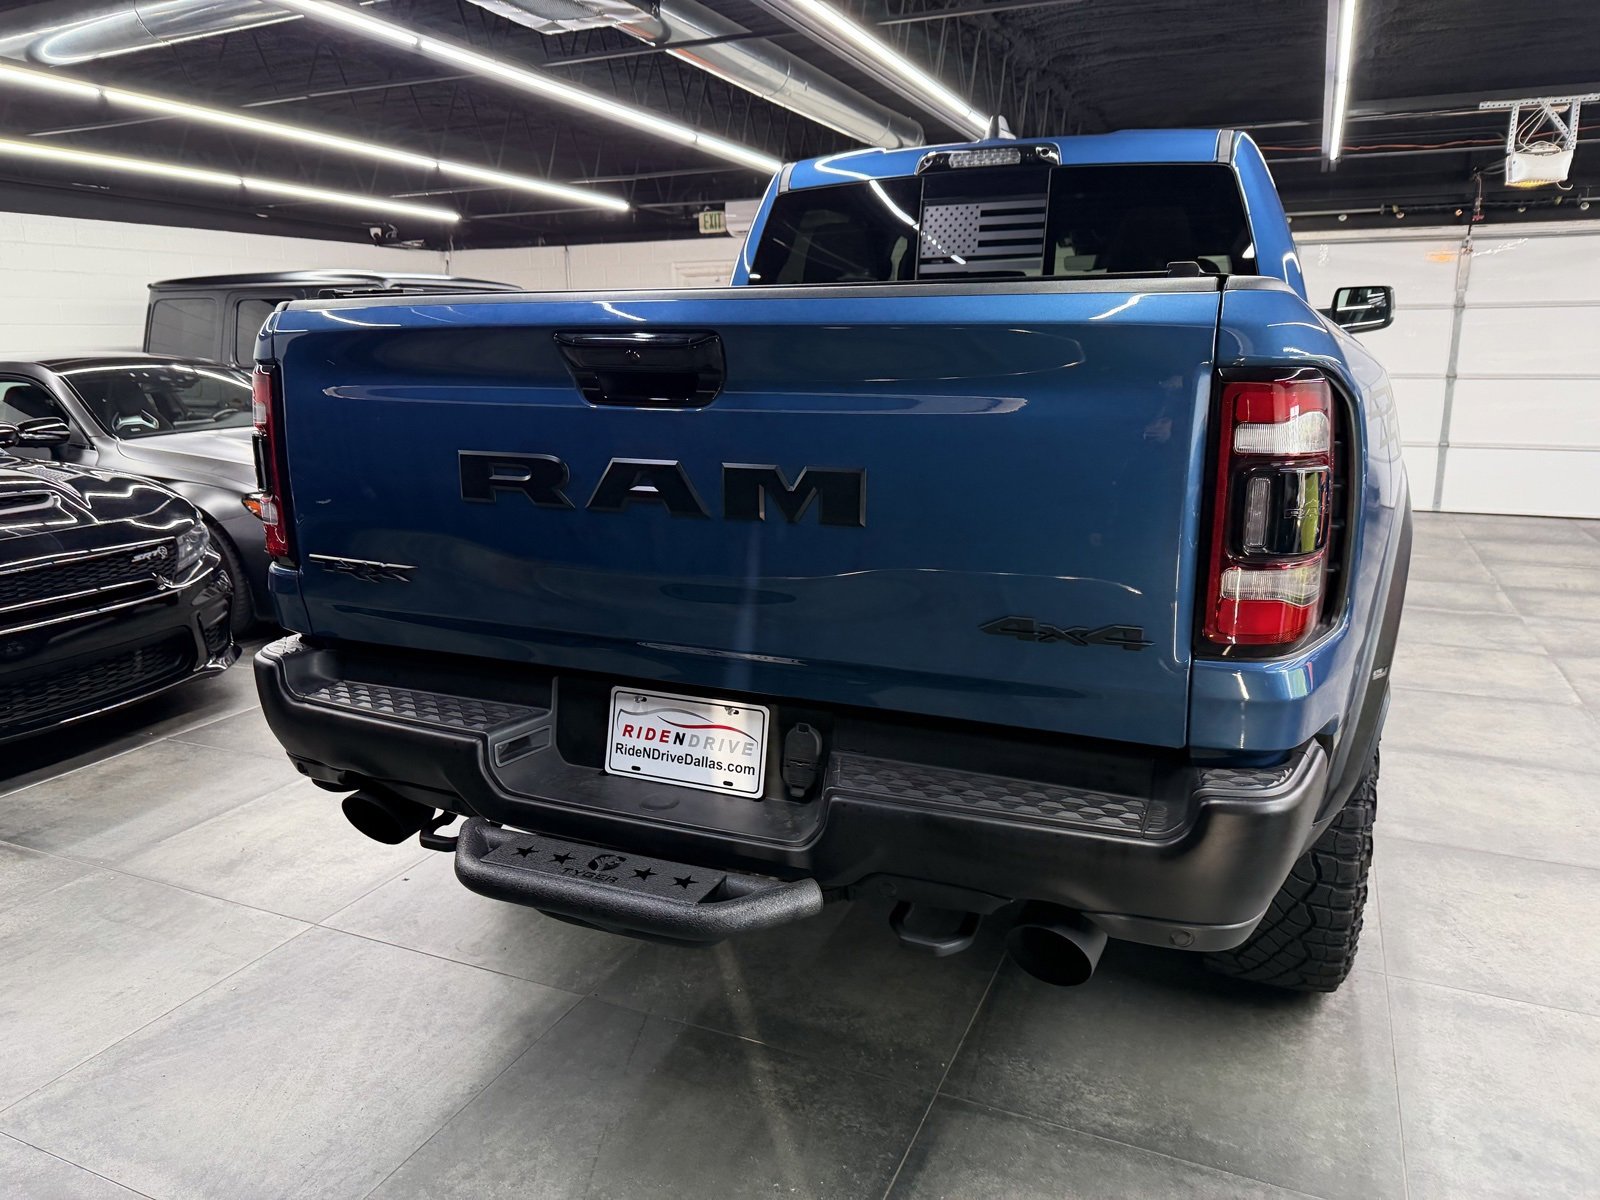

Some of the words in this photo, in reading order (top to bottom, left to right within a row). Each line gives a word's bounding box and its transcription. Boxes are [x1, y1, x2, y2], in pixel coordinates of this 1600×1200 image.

[703, 213, 721, 230] EXIT
[458, 449, 867, 528] RAM
[614, 742, 756, 776] RideNDriveDallas.com
[562, 867, 619, 884] TYGER
